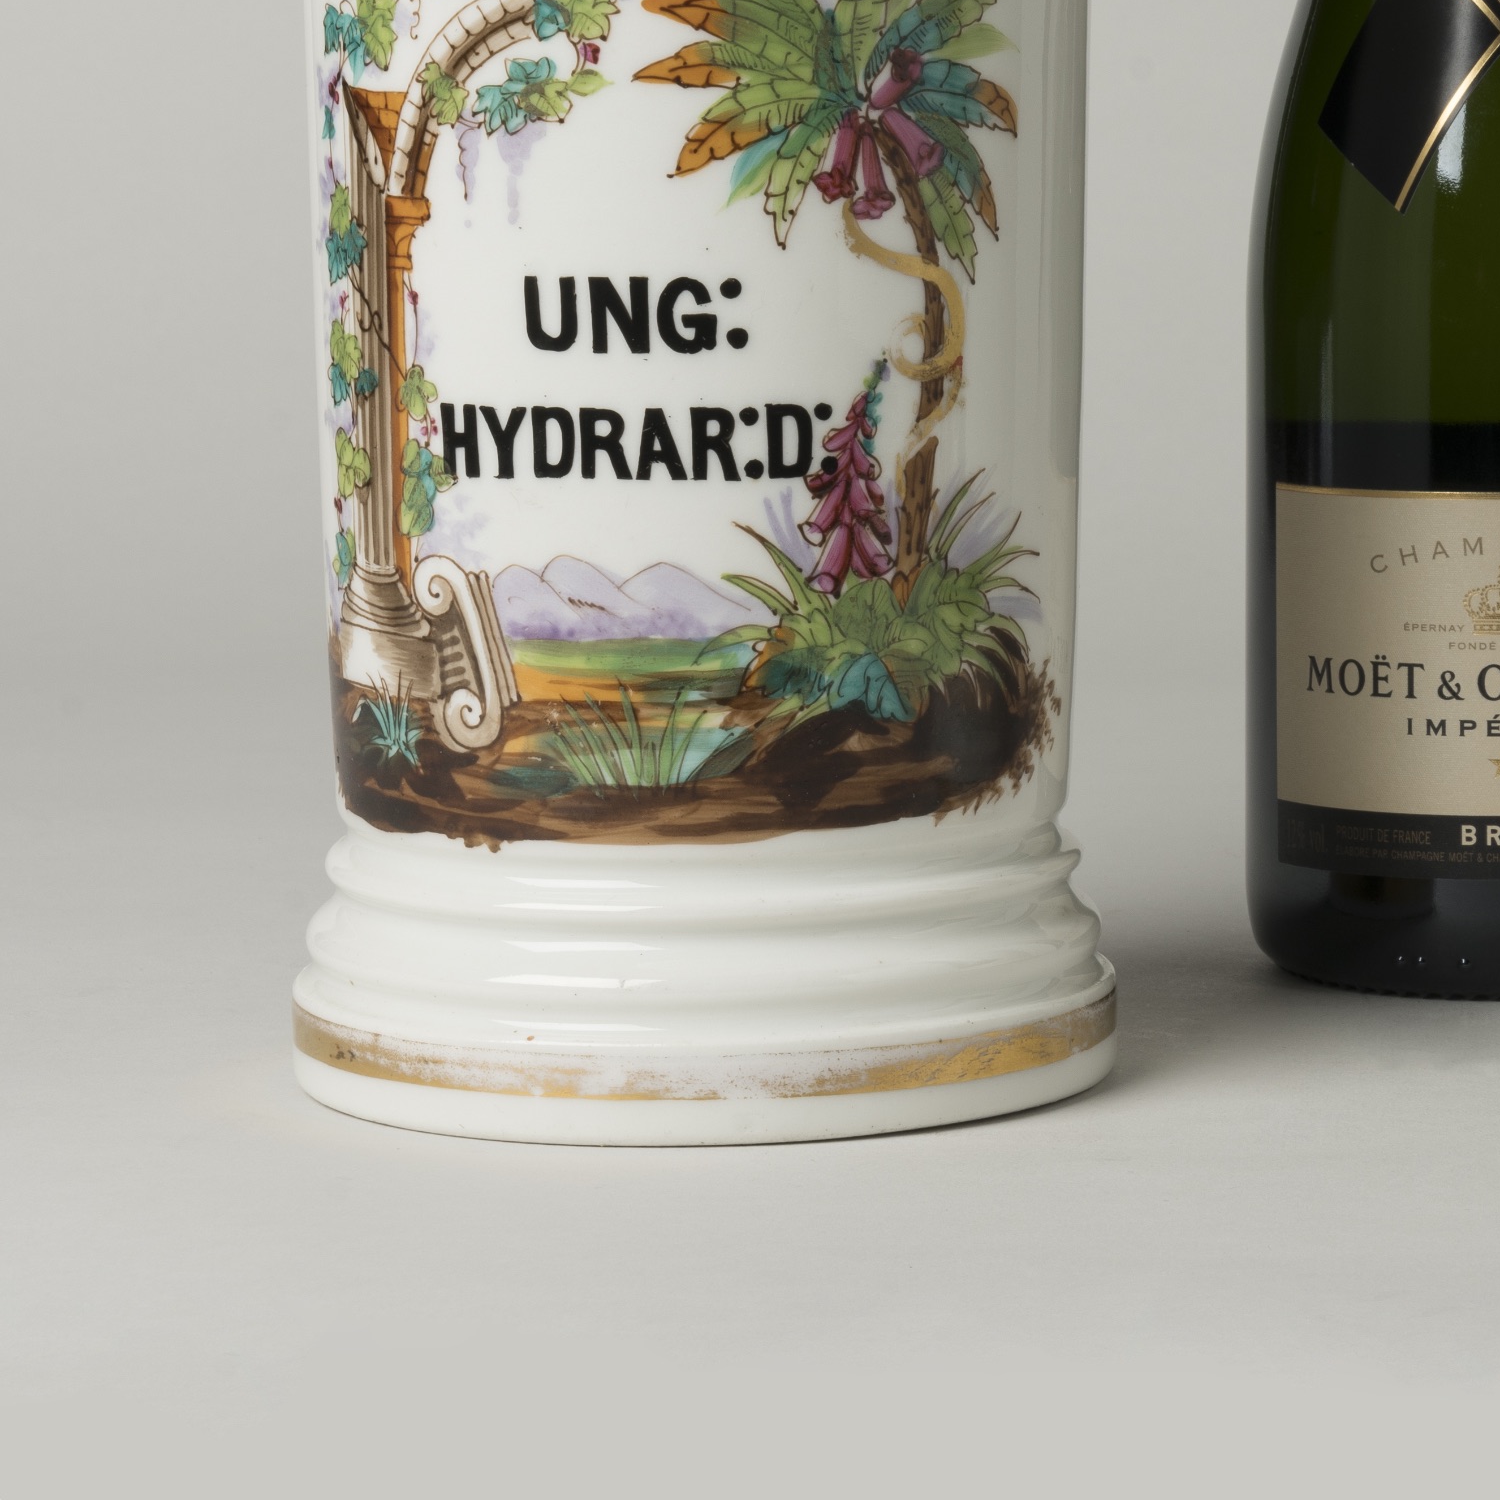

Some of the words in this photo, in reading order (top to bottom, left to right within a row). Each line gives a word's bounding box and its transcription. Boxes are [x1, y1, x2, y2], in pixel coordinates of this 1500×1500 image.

[524, 275, 749, 355] UNG:
[1403, 622, 1465, 633] ÉPERNAY
[1448, 640, 1497, 651] FONDÉ
[1306, 654, 1426, 700] MOËT
[1436, 669, 1466, 701] &
[1336, 824, 1375, 842] PRODUIT
[1377, 828, 1389, 843] DE
[1393, 829, 1432, 846] FRANCE
[1391, 849, 1445, 862] CHAMPAGNE
[1476, 852, 1484, 863] &
